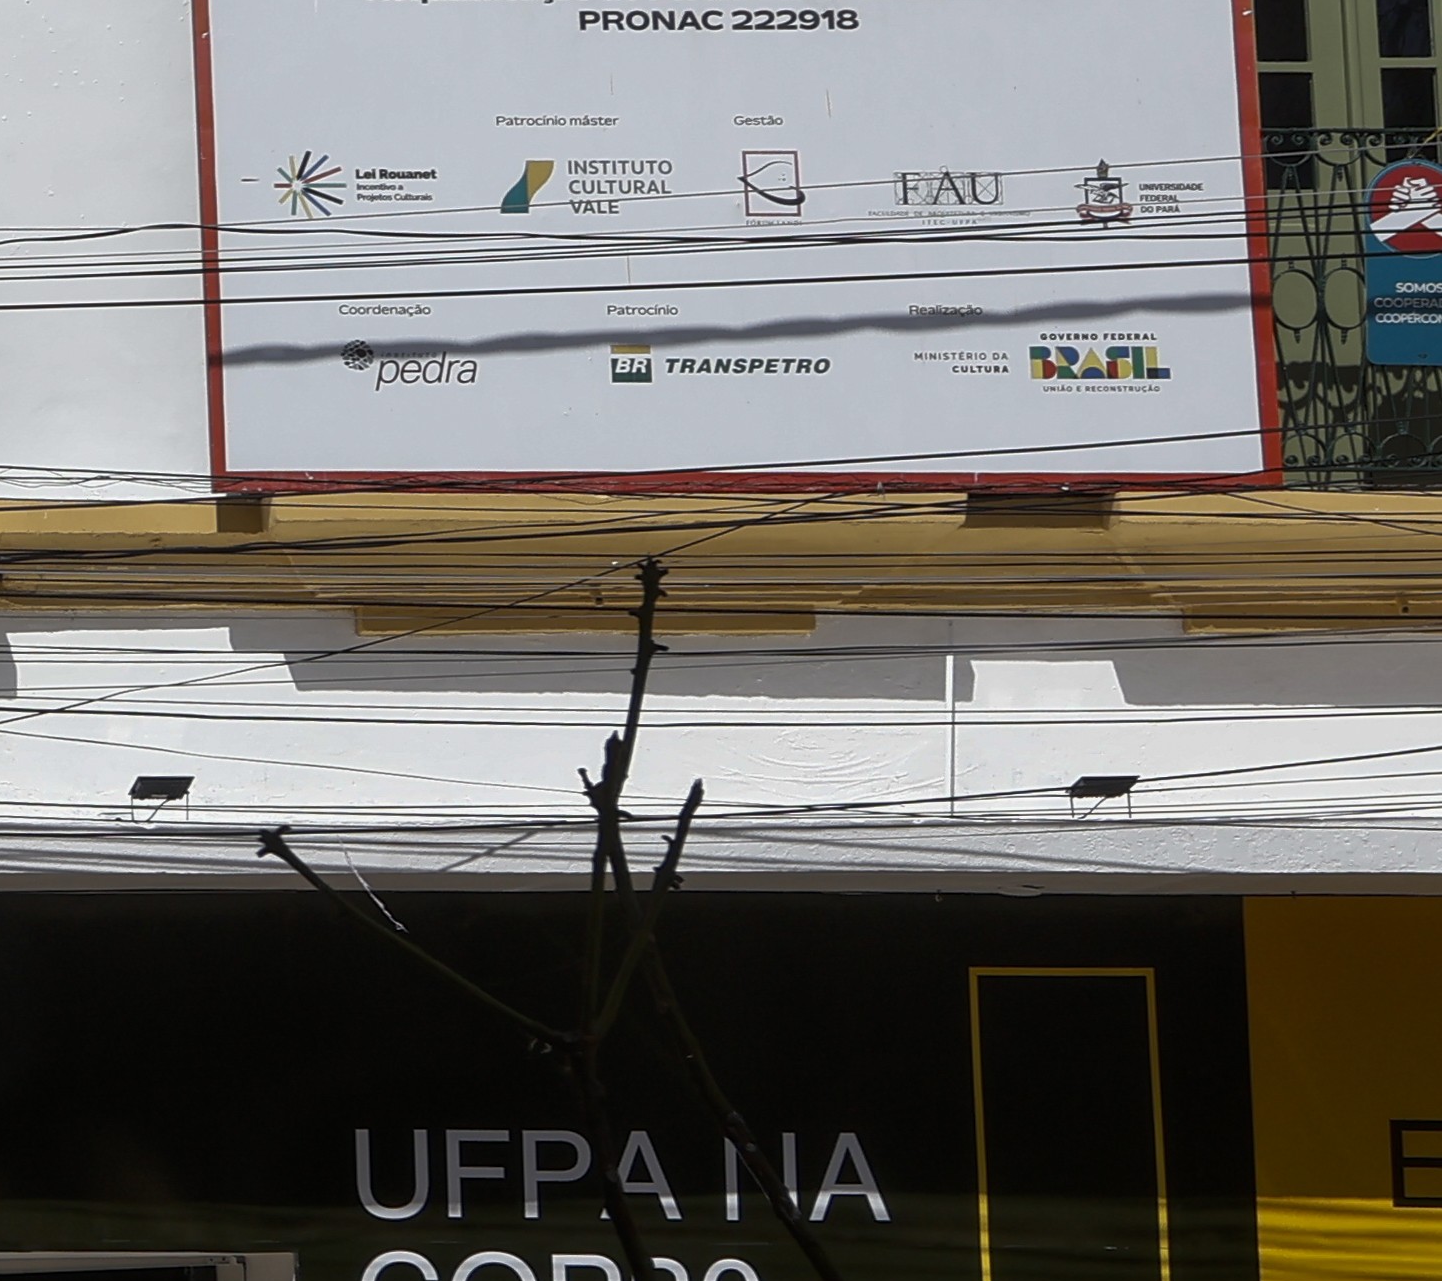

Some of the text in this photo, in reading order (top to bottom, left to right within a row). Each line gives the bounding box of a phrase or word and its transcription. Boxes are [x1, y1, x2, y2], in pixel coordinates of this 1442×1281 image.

[578, 9, 860, 31] PRONAC 222918
[495, 113, 620, 127] Patrocínio máster
[733, 113, 784, 127] Gestão
[355, 168, 438, 180] Lei Rouanet
[567, 159, 673, 175] INSTITUTO
[356, 183, 397, 191] Incentivo
[567, 179, 672, 196] CULTURAL
[899, 168, 1001, 206] FAU
[1138, 182, 1204, 192] UNIVERSIDADE
[356, 193, 433, 203] Projetos Culturais
[1139, 194, 1179, 202] FEDERAL
[569, 199, 620, 215] VALE
[1140, 205, 1154, 213] DO
[1155, 203, 1181, 213] PARÁ
[1395, 282, 1442, 294] SOMOS
[338, 304, 432, 318] Coordenação
[606, 304, 679, 316] Patrocínio
[908, 304, 984, 319] Realização
[1039, 332, 1158, 341] GOVERNO FEDERAL
[913, 351, 1009, 361] MINISTÉRIO DA
[1029, 346, 1171, 380] BRASIL
[375, 351, 478, 391] pedra
[615, 357, 831, 375] BR TRANSPETRO
[951, 365, 1009, 374] CULTURA
[1042, 383, 1161, 394] UNIÃO E RECONSTRUÇÃO
[353, 1127, 893, 1222] UFPA NA
